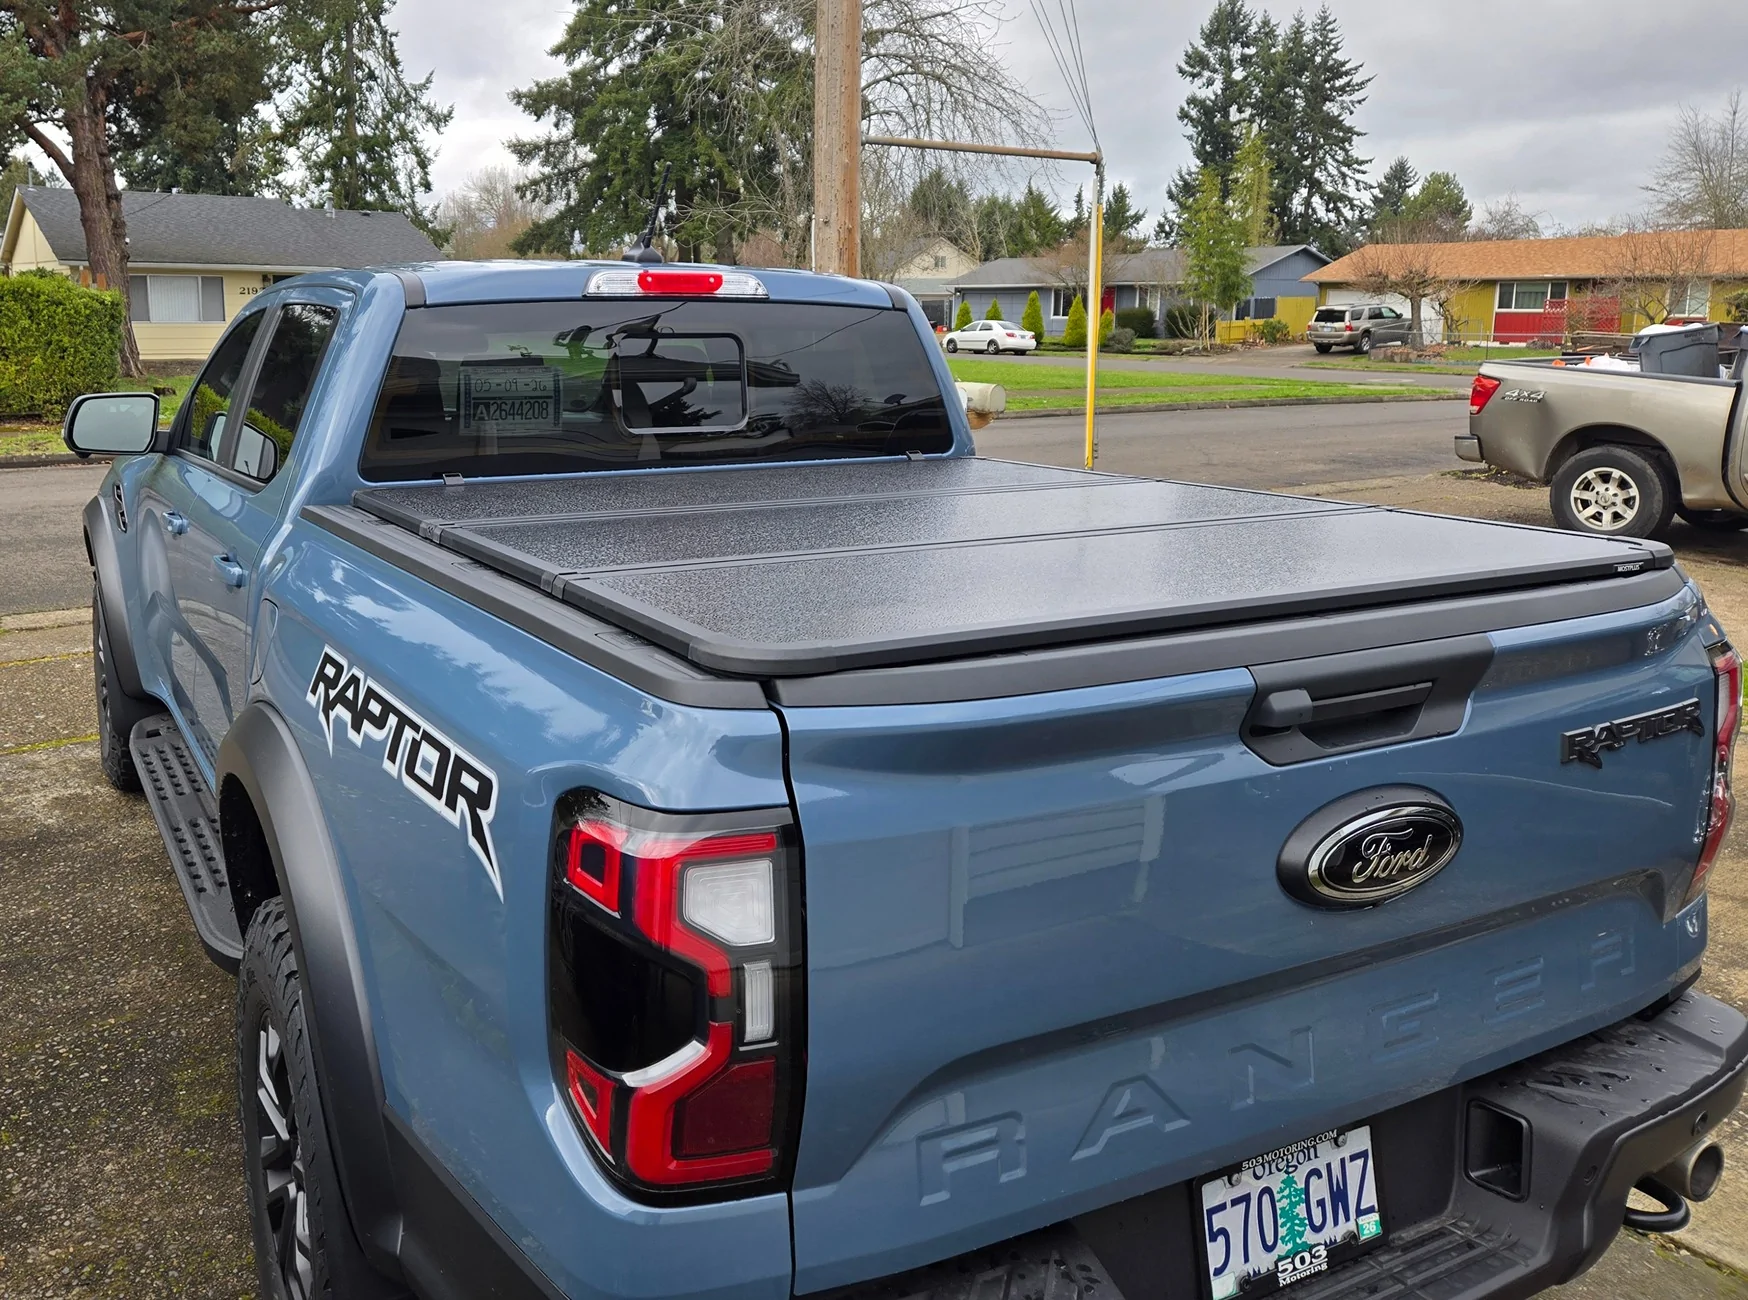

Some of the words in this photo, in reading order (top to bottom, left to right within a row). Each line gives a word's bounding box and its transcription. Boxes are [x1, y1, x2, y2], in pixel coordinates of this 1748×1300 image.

[472, 401, 549, 421] A2644208
[1560, 697, 1706, 769] RAPTOR
[306, 643, 504, 904] RAPTOR
[1352, 828, 1434, 884] Ford
[916, 927, 1636, 1206] RANGER
[1206, 1186, 1279, 1277] 570
[1304, 1148, 1376, 1234] GWZ
[1363, 1221, 1377, 1235] 26
[1277, 1244, 1328, 1276] 503
[1279, 1262, 1328, 1287] Motoring
